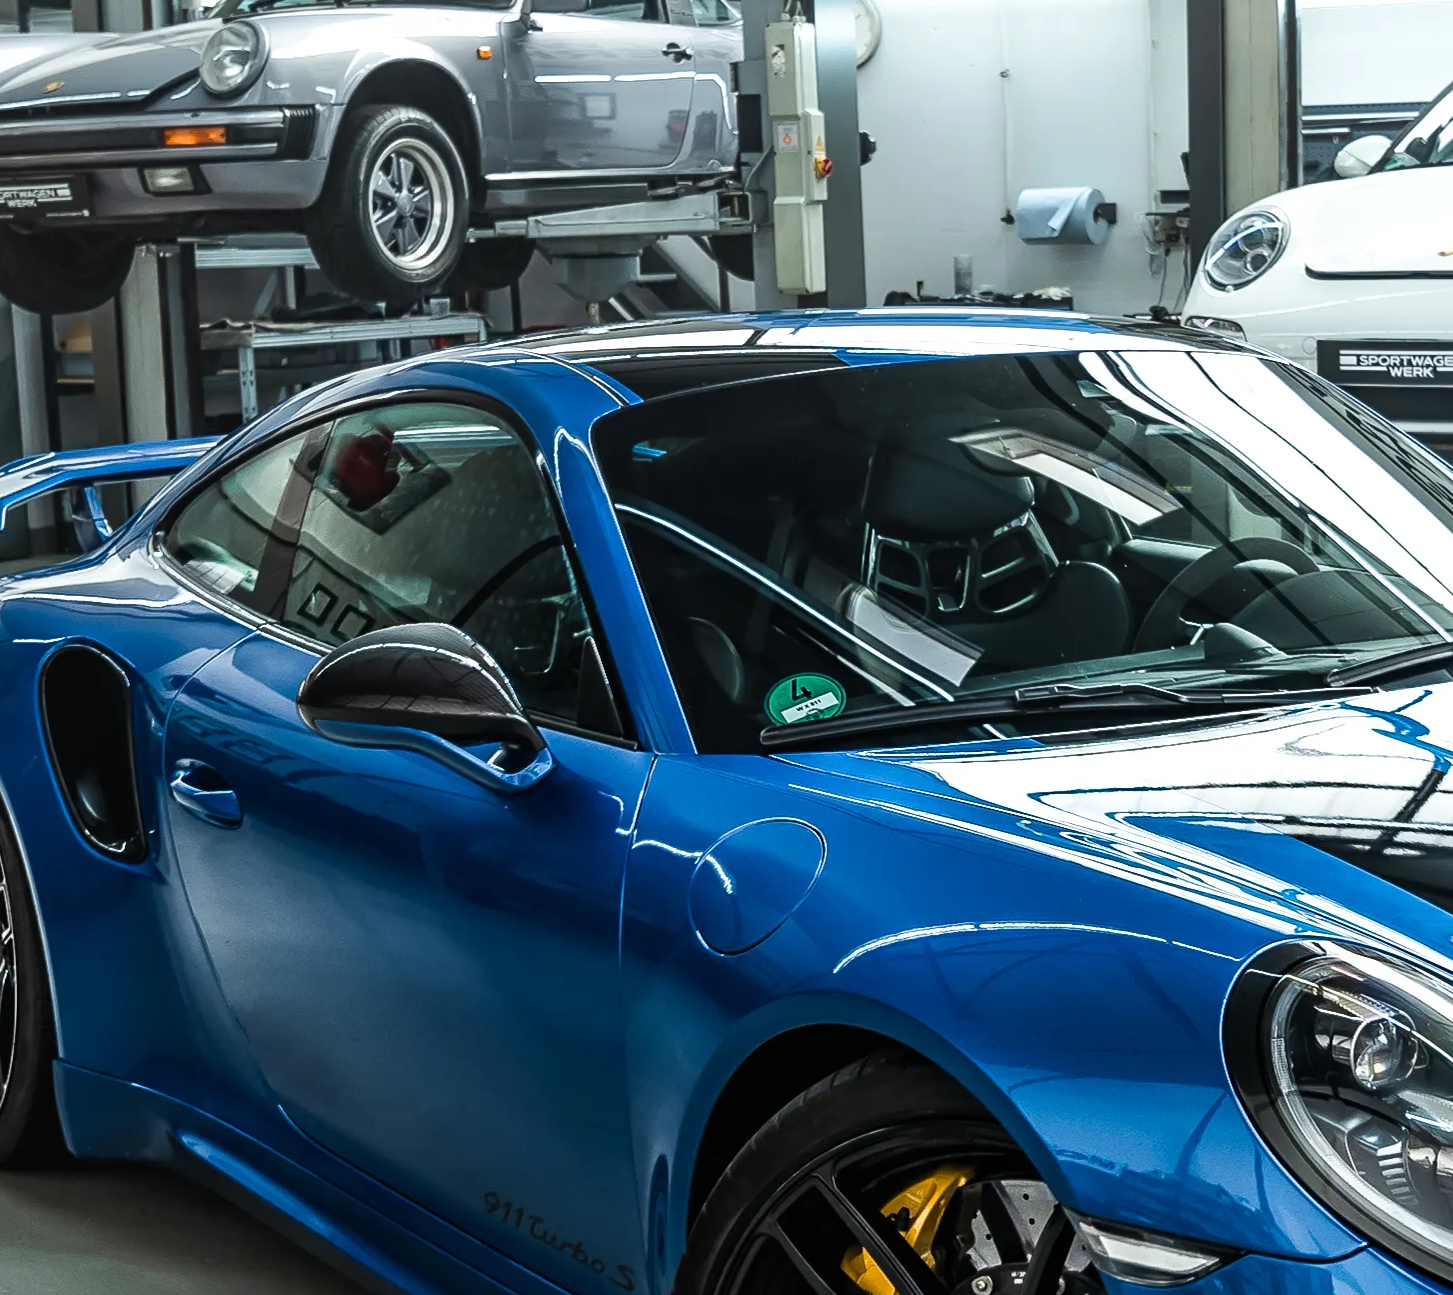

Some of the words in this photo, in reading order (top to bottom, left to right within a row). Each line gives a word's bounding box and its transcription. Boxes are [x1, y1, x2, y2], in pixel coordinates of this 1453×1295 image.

[5, 199, 38, 208] WERK
[1389, 366, 1435, 378] WERK
[791, 678, 812, 702] 4
[483, 1191, 524, 1229] 911
[528, 1214, 606, 1275] Turbo
[607, 1263, 637, 1293] S
